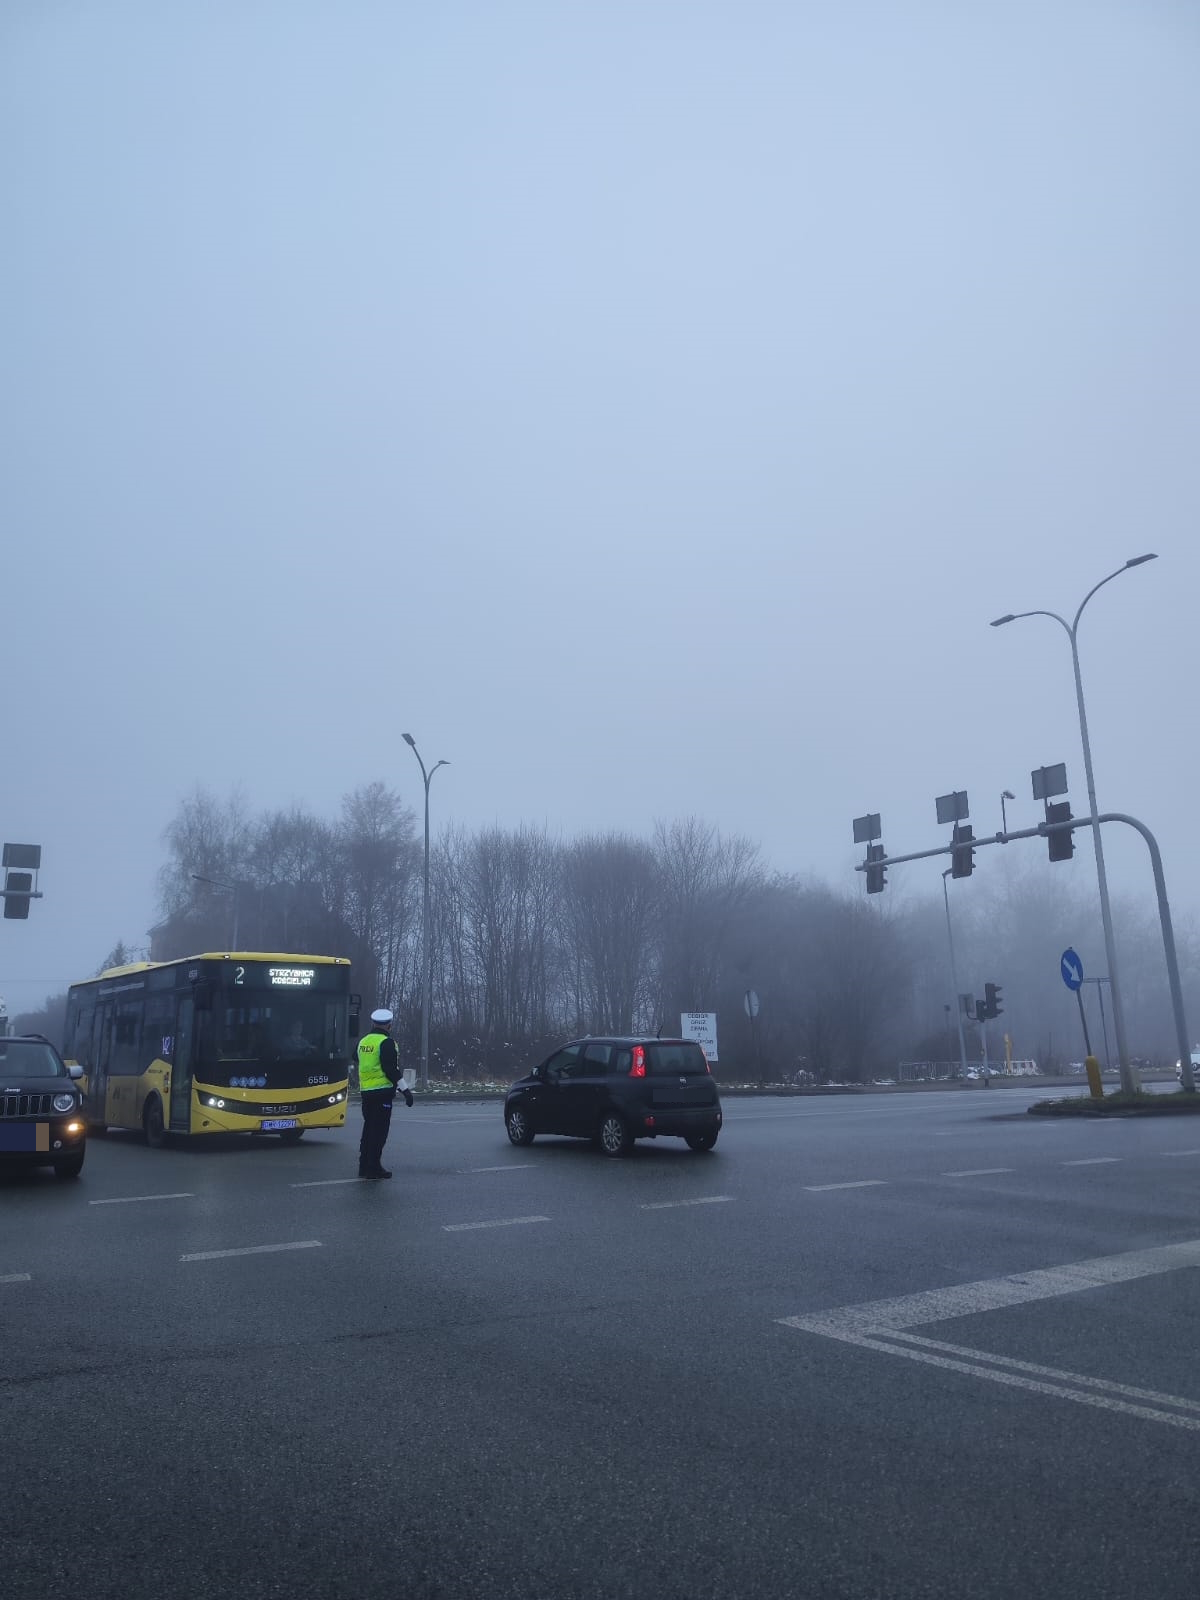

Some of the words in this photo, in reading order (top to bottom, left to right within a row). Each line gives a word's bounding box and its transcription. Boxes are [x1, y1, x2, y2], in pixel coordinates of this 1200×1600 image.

[234, 966, 245, 985] 2
[308, 1075, 329, 1084] 6559
[261, 1105, 297, 1114] ISUZU
